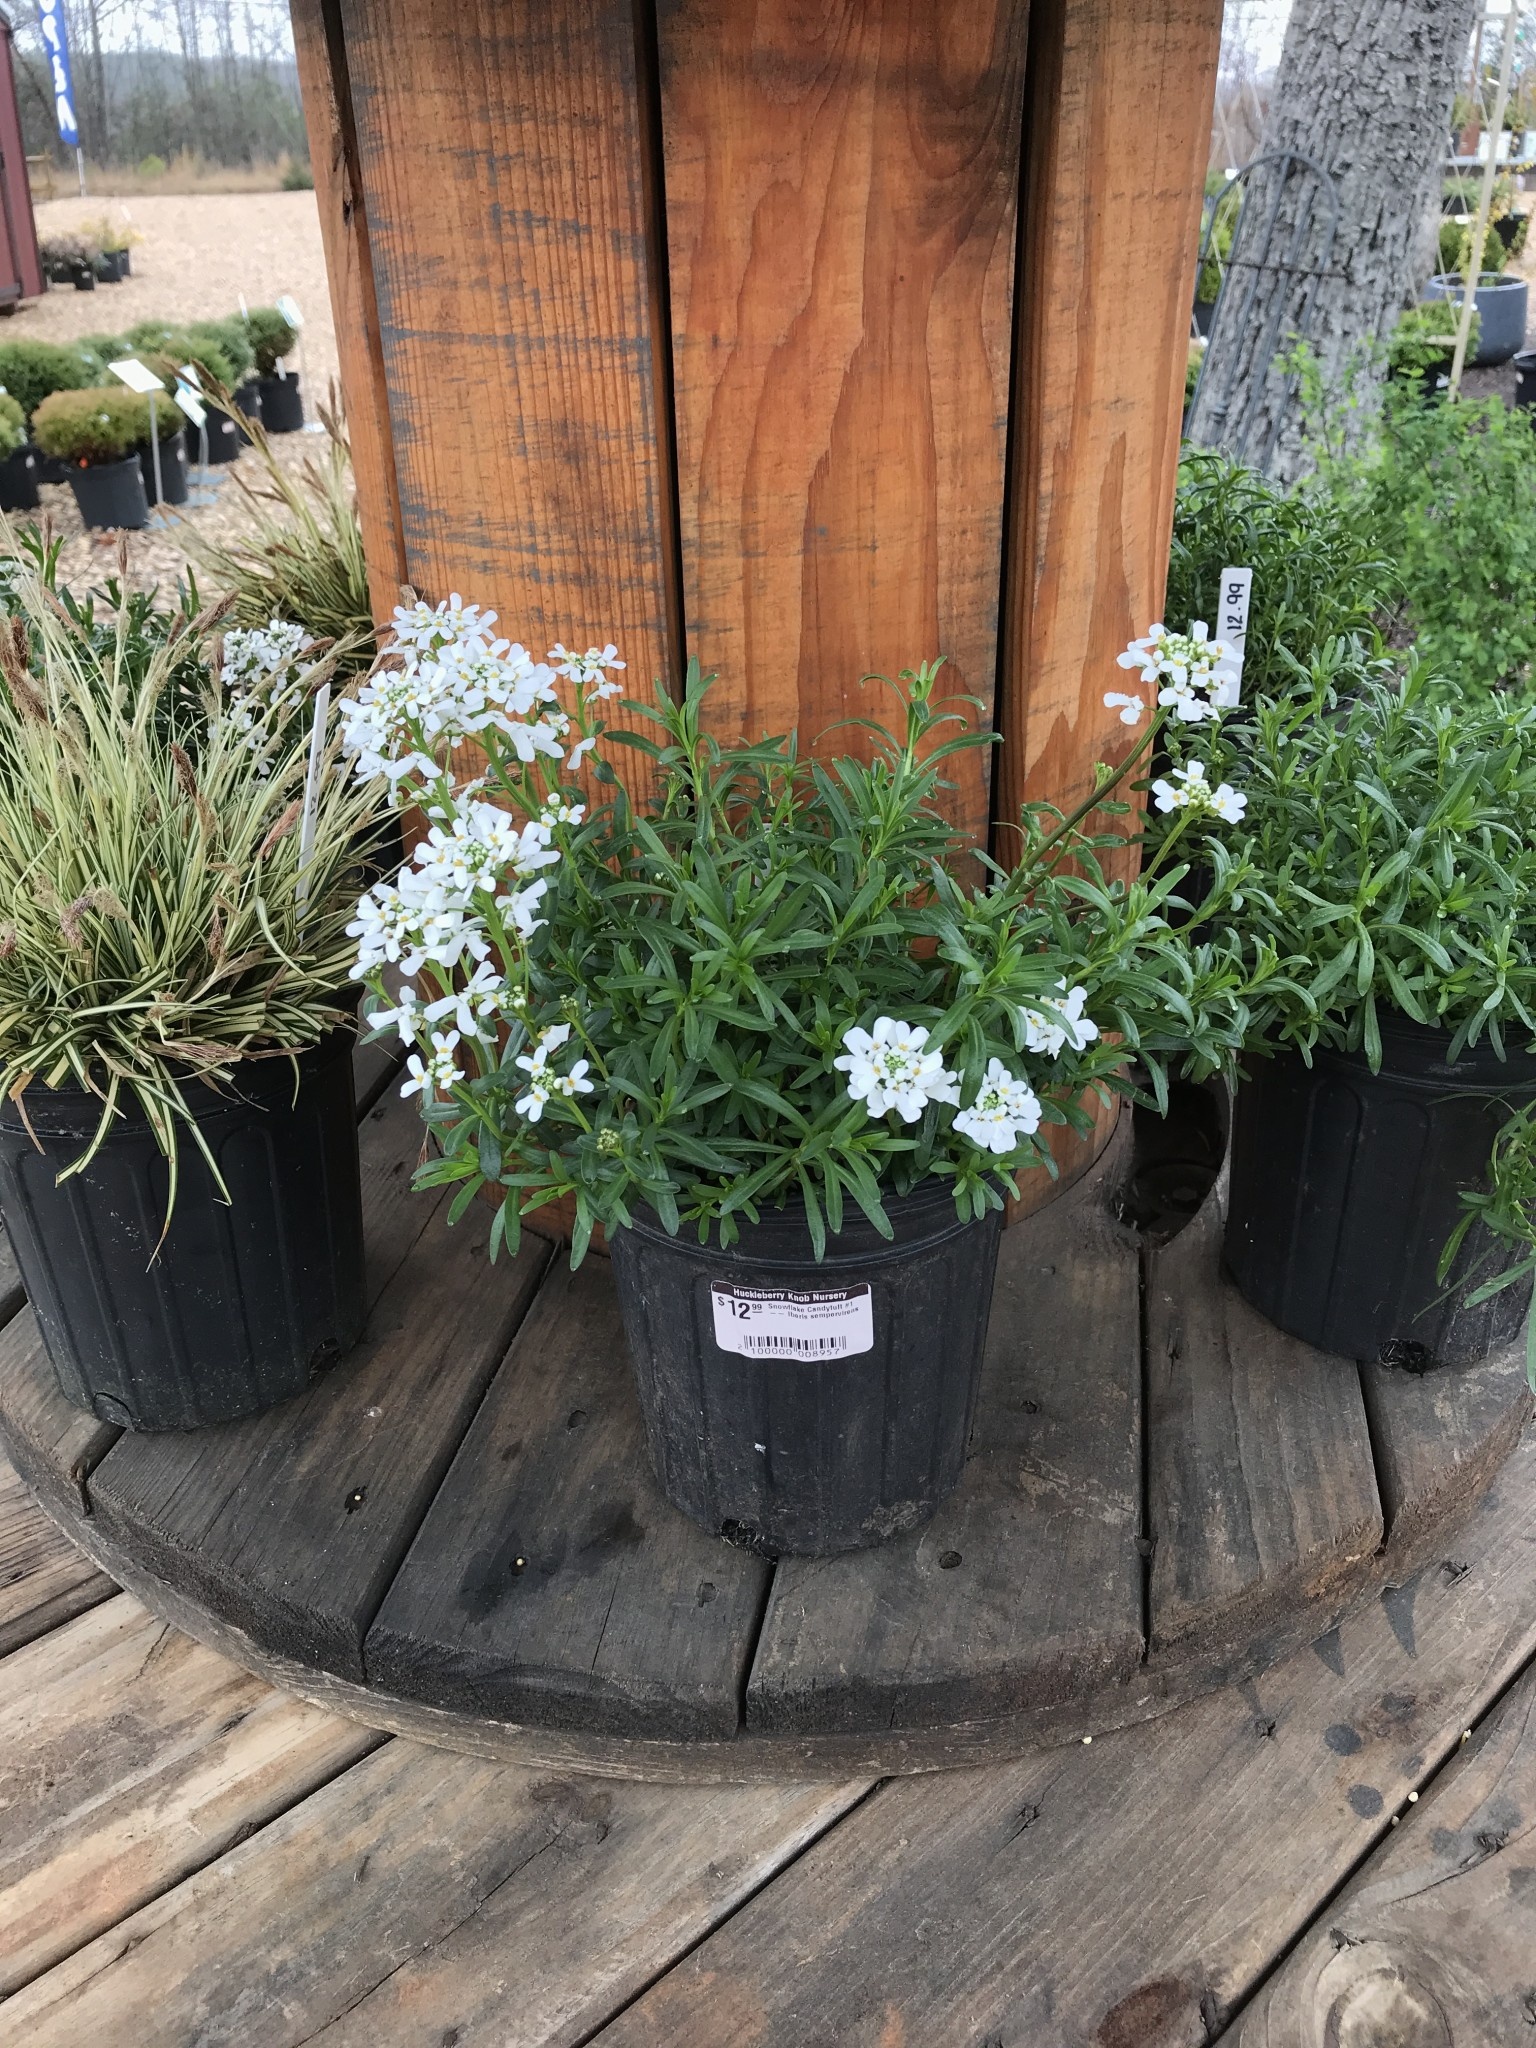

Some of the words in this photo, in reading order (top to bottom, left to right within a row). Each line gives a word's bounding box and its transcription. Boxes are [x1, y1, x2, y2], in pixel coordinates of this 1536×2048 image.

[1226, 582, 1245, 631] 12.99
[733, 1287, 785, 1301] Huckleberry
[787, 1292, 810, 1302] Knob
[813, 1291, 848, 1301] Nursery
[768, 1303, 805, 1313] Snowflake
[807, 1304, 843, 1313] Candytuft
[787, 1311, 808, 1319] Iberis
[810, 1307, 859, 1319] sempervirens
